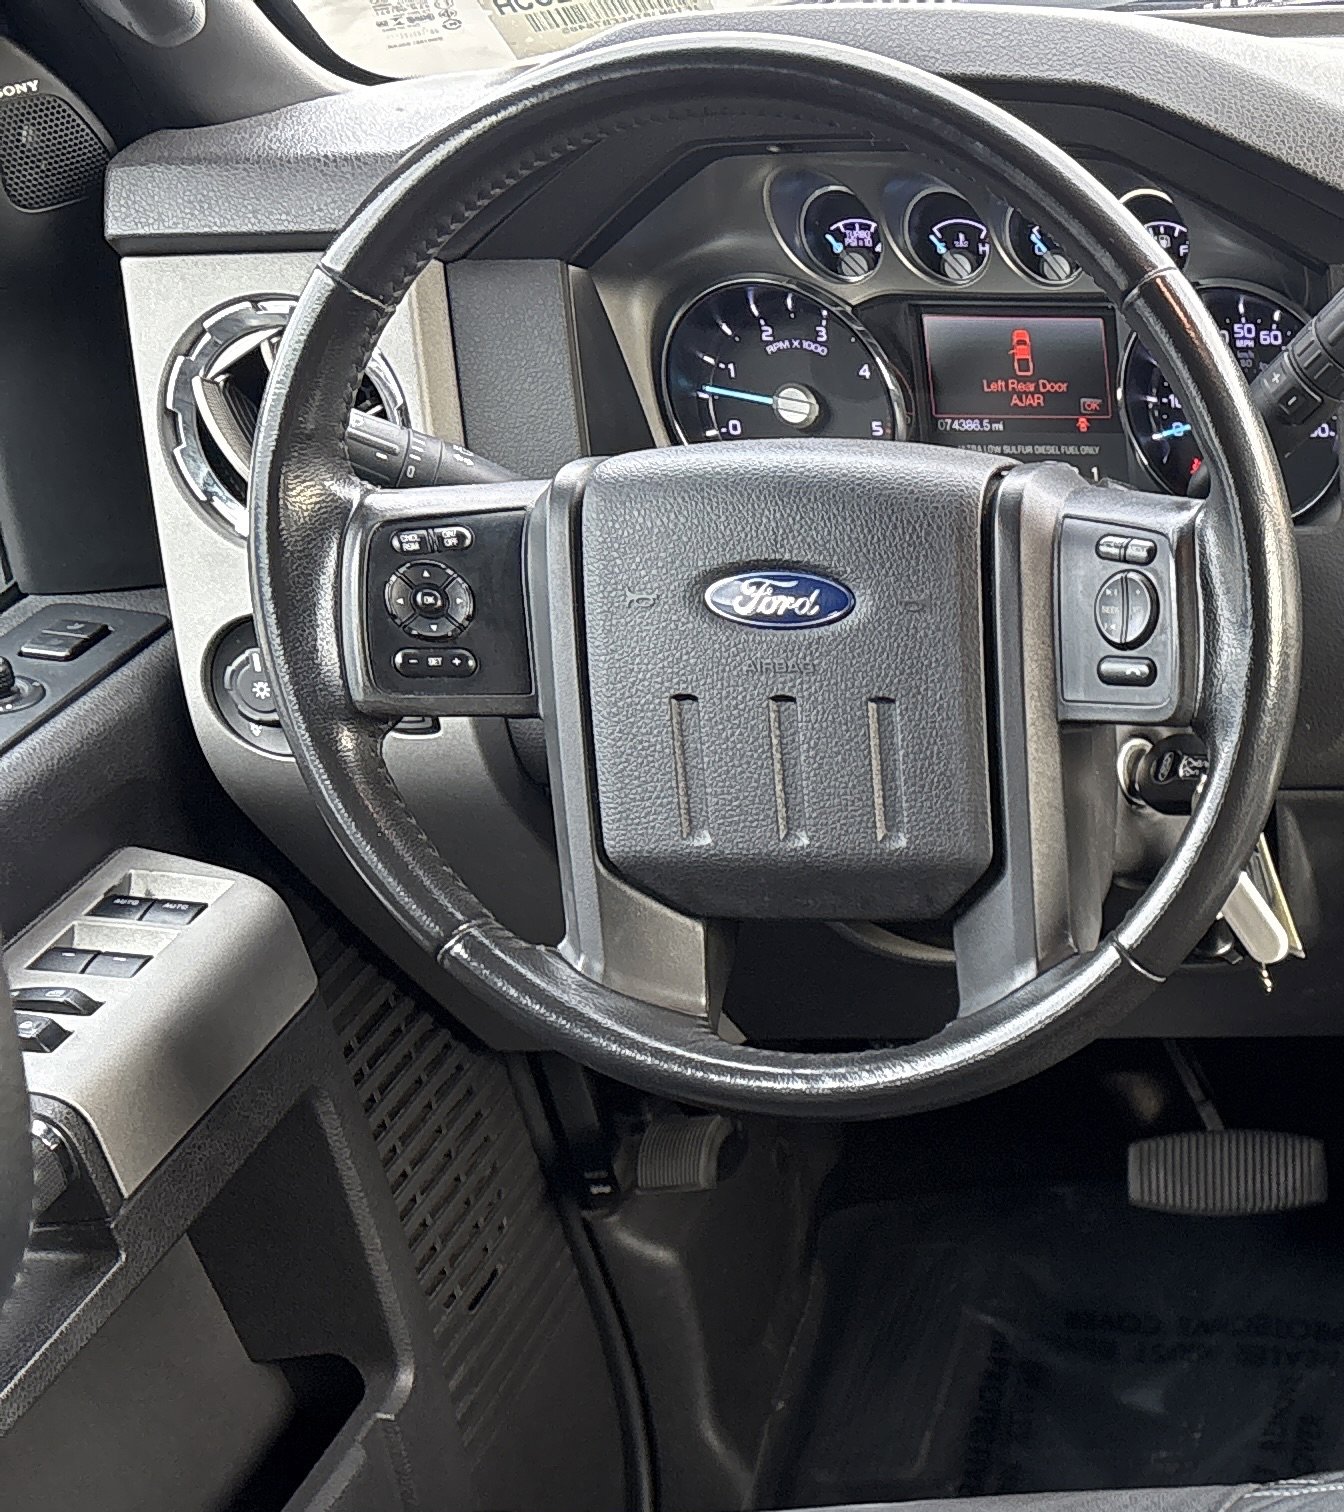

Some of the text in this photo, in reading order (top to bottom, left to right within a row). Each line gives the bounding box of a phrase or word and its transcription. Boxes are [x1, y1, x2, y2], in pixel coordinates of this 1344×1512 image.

[0, 79, 39, 98] ONY
[978, 243, 990, 255] H
[1179, 244, 1189, 257] F
[761, 326, 774, 341] 2
[815, 326, 828, 342] 3
[1233, 323, 1256, 338] 50
[1259, 330, 1283, 346] 60
[765, 338, 791, 355] RPM
[801, 339, 829, 356] 1000
[727, 362, 736, 378] 1
[859, 363, 871, 379] 4
[982, 379, 1069, 393] Left Rear Door
[1009, 394, 1045, 407] AJAR
[1084, 401, 1101, 411] OK
[729, 419, 742, 435] 0
[871, 421, 884, 436] 5
[991, 420, 1004, 432] mi
[1002, 444, 1033, 455] SULFUR
[1035, 445, 1061, 455] DIESEL
[1061, 445, 1080, 456] FUEL
[733, 577, 821, 617] Ford
[745, 659, 816, 674] AIRBAG
[113, 898, 140, 906] AUTO
[162, 902, 189, 910] AUTO
